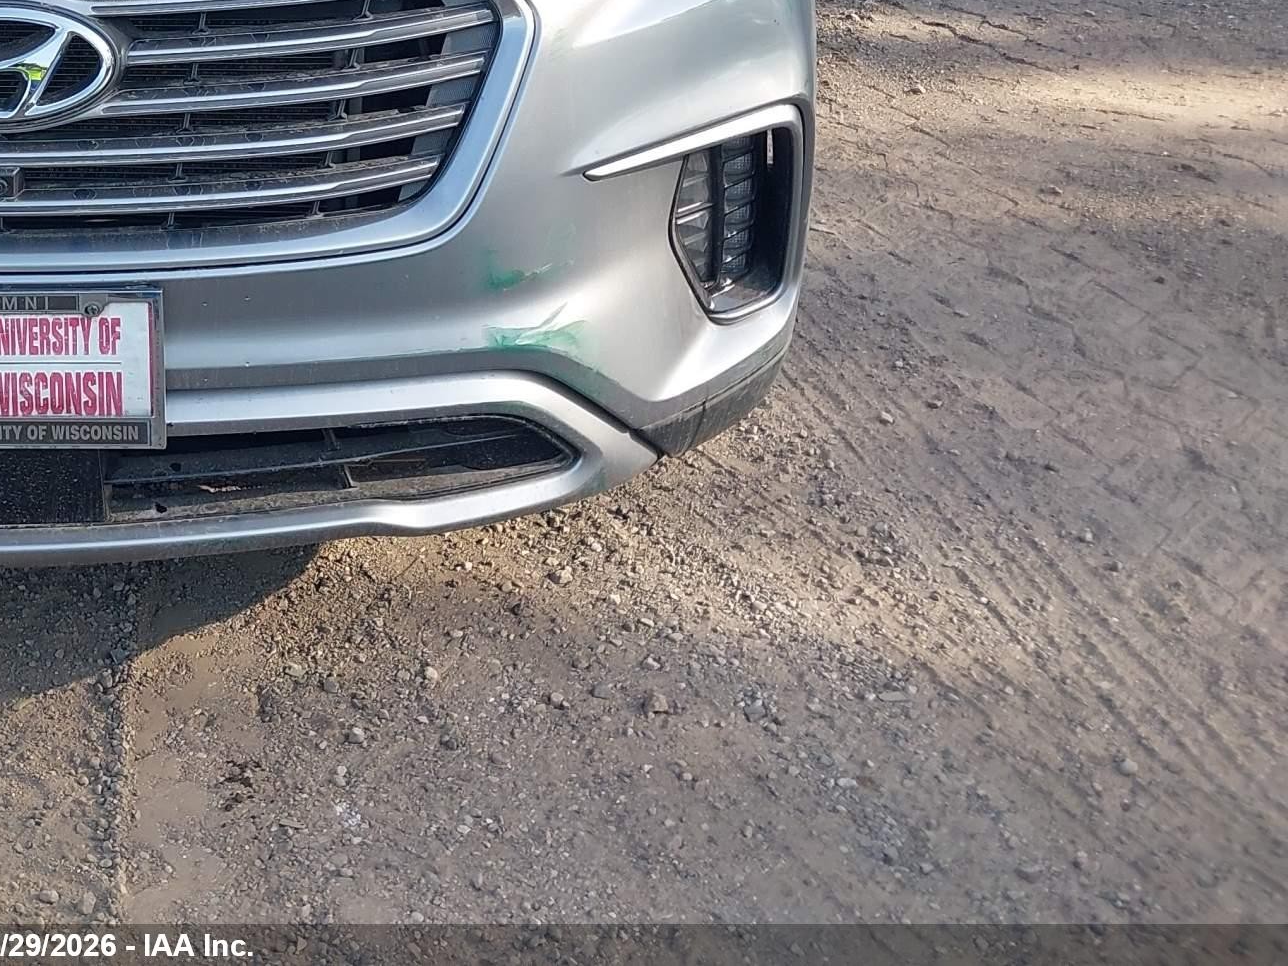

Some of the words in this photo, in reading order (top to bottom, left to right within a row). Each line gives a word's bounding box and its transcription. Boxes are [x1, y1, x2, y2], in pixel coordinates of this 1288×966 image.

[98, 317, 121, 356] OF
[27, 424, 47, 441] OF
[52, 424, 139, 441] WISCONSIN
